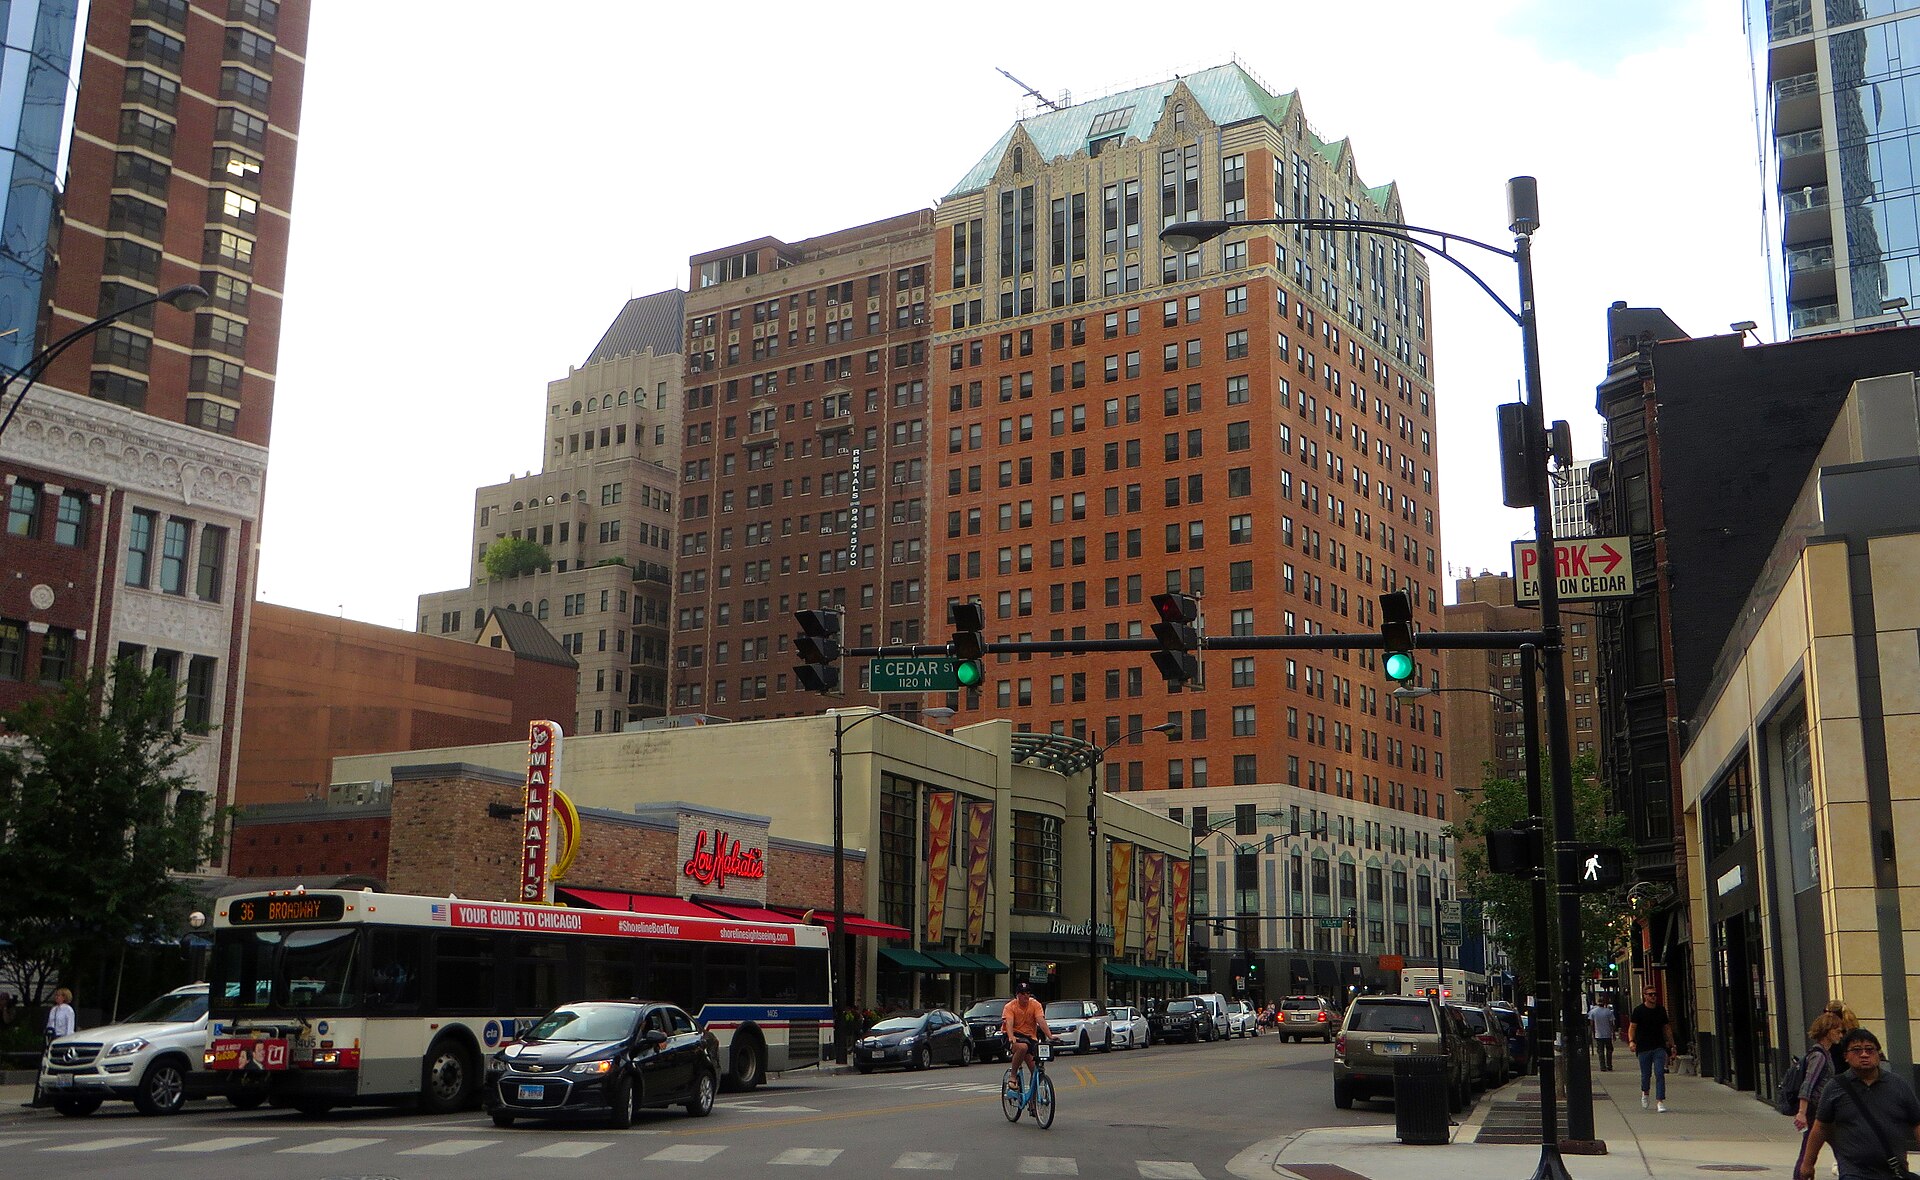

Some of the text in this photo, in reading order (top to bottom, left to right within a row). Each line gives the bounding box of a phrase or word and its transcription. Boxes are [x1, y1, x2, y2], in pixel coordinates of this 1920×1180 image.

[852, 449, 860, 499] RENTALS
[1521, 545, 1590, 579] PRK
[1560, 579, 1577, 594] ON
[1582, 576, 1626, 593] CEDAR
[875, 664, 880, 674] E
[885, 662, 938, 676] CEDAR
[899, 678, 931, 688] 1120 N
[524, 727, 548, 898] Lou MALNATI'S
[684, 829, 764, 889] Lou Malnati's
[241, 900, 321, 921] 36 BROADWAY
[459, 907, 582, 930] YOUR GUIDE TO CHICAGO!
[618, 920, 680, 935] #ShorelineBoatTour
[720, 928, 788, 943] shorelinesightseeing.com
[1052, 919, 1085, 935] Barnes
[486, 1029, 498, 1038] cta
